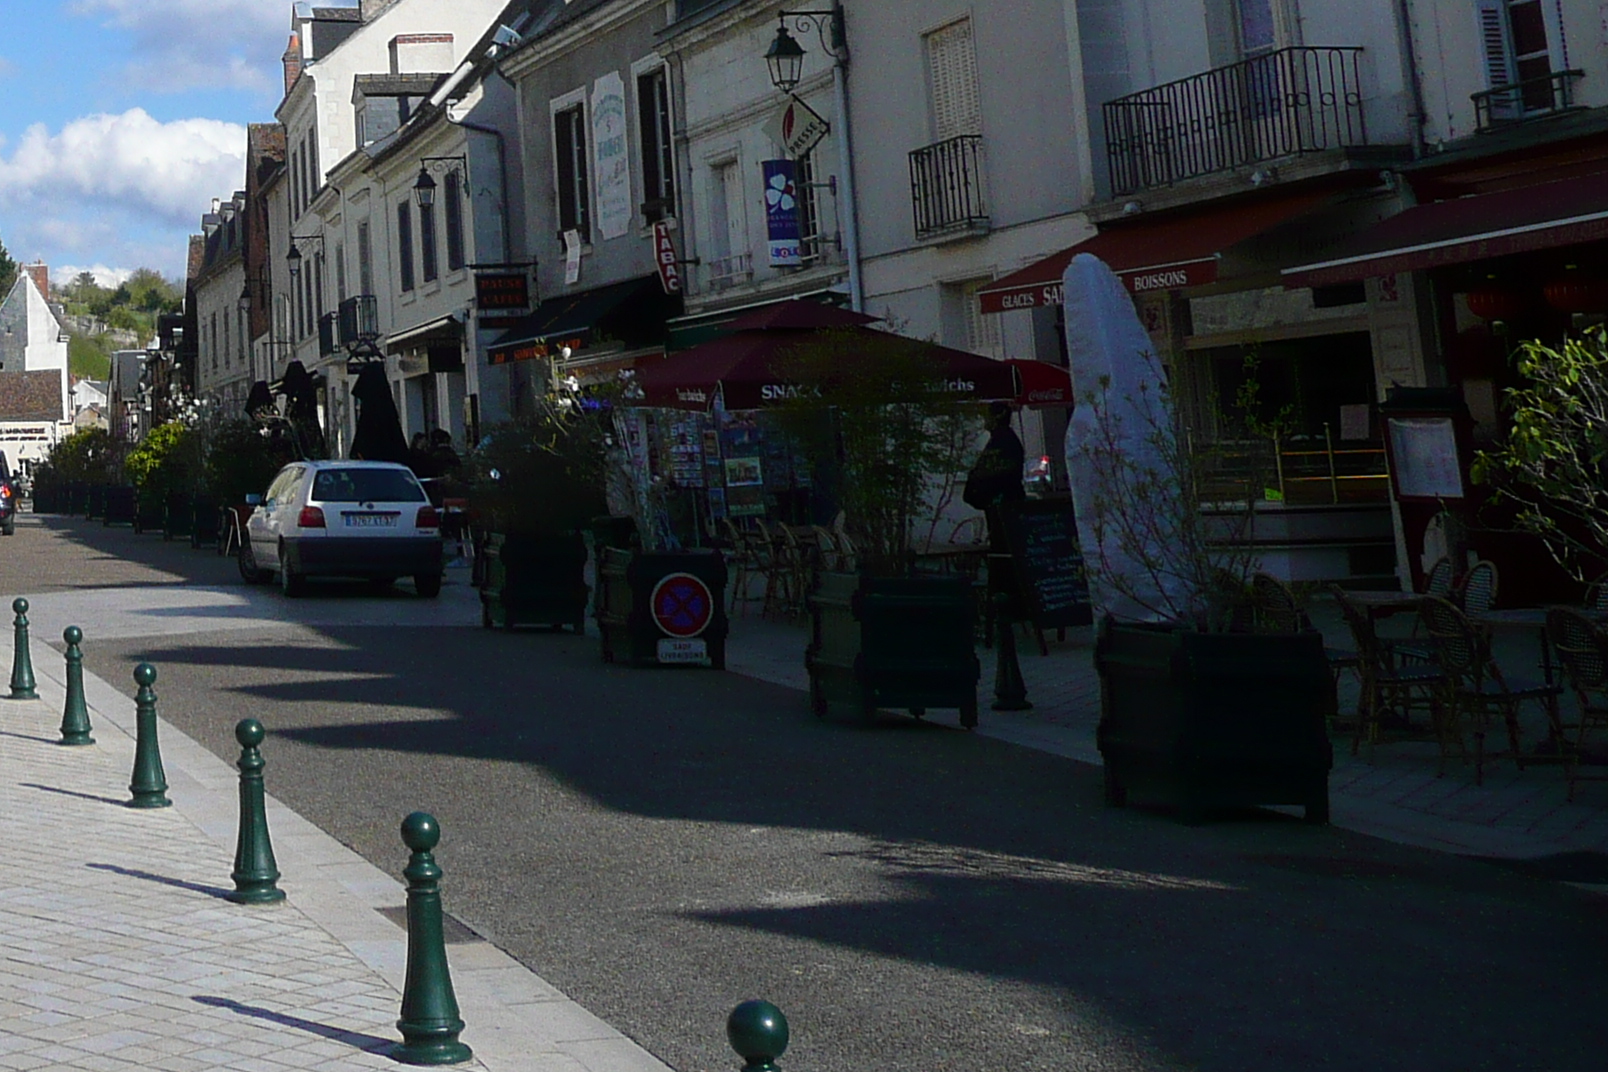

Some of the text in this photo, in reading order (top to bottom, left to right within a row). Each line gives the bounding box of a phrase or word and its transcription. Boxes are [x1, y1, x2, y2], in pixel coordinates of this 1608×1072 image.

[789, 121, 819, 155] PRESSE
[657, 224, 679, 290] TABAC
[1134, 270, 1188, 291] BOISSONS
[1002, 292, 1035, 308] GLACES
